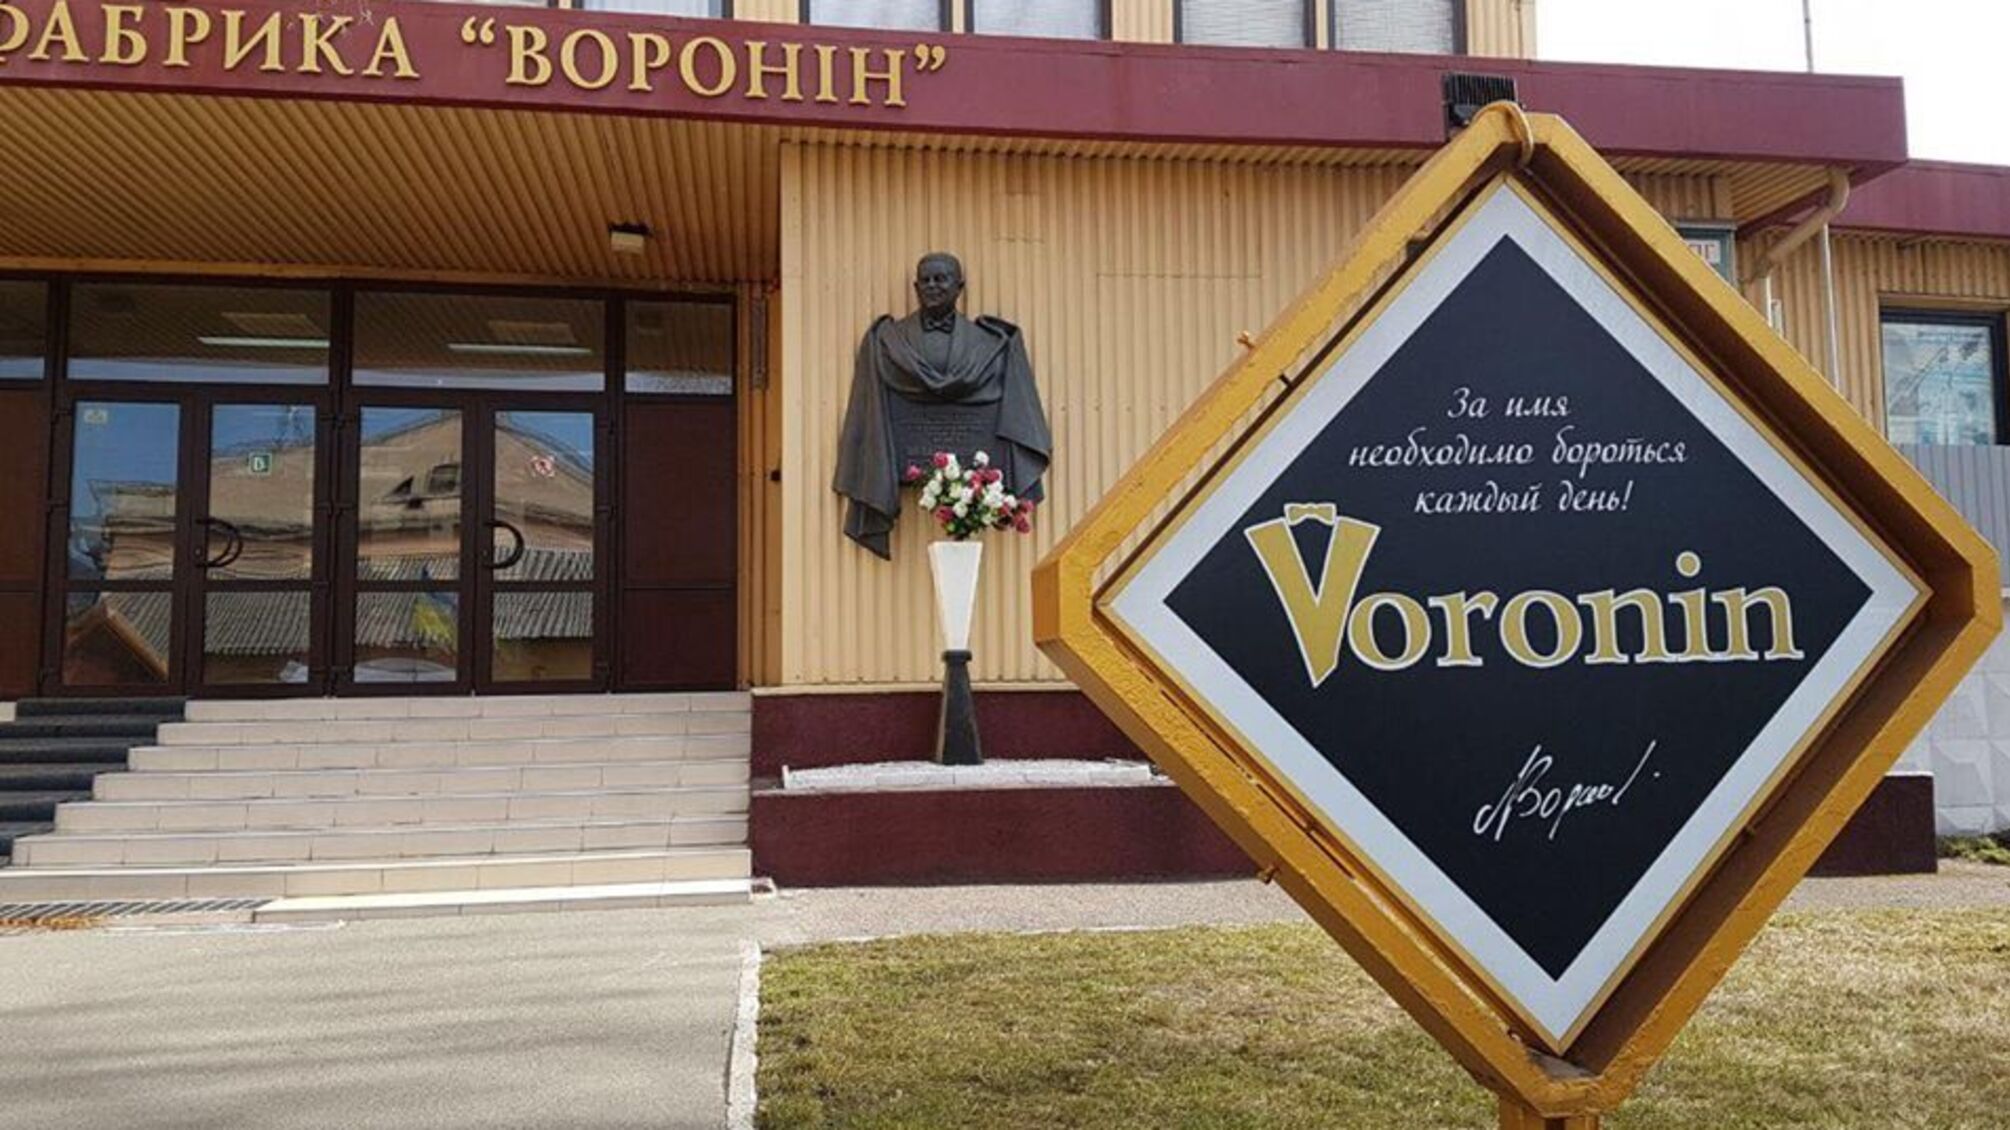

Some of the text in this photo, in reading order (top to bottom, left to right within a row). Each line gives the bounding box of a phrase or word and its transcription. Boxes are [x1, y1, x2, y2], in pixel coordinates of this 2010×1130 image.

[1448, 387, 1571, 418] За имя
[1348, 425, 1687, 478] необходимо бороться
[1414, 480, 1634, 514] каждый день!
[1244, 503, 1805, 688] Voronin
